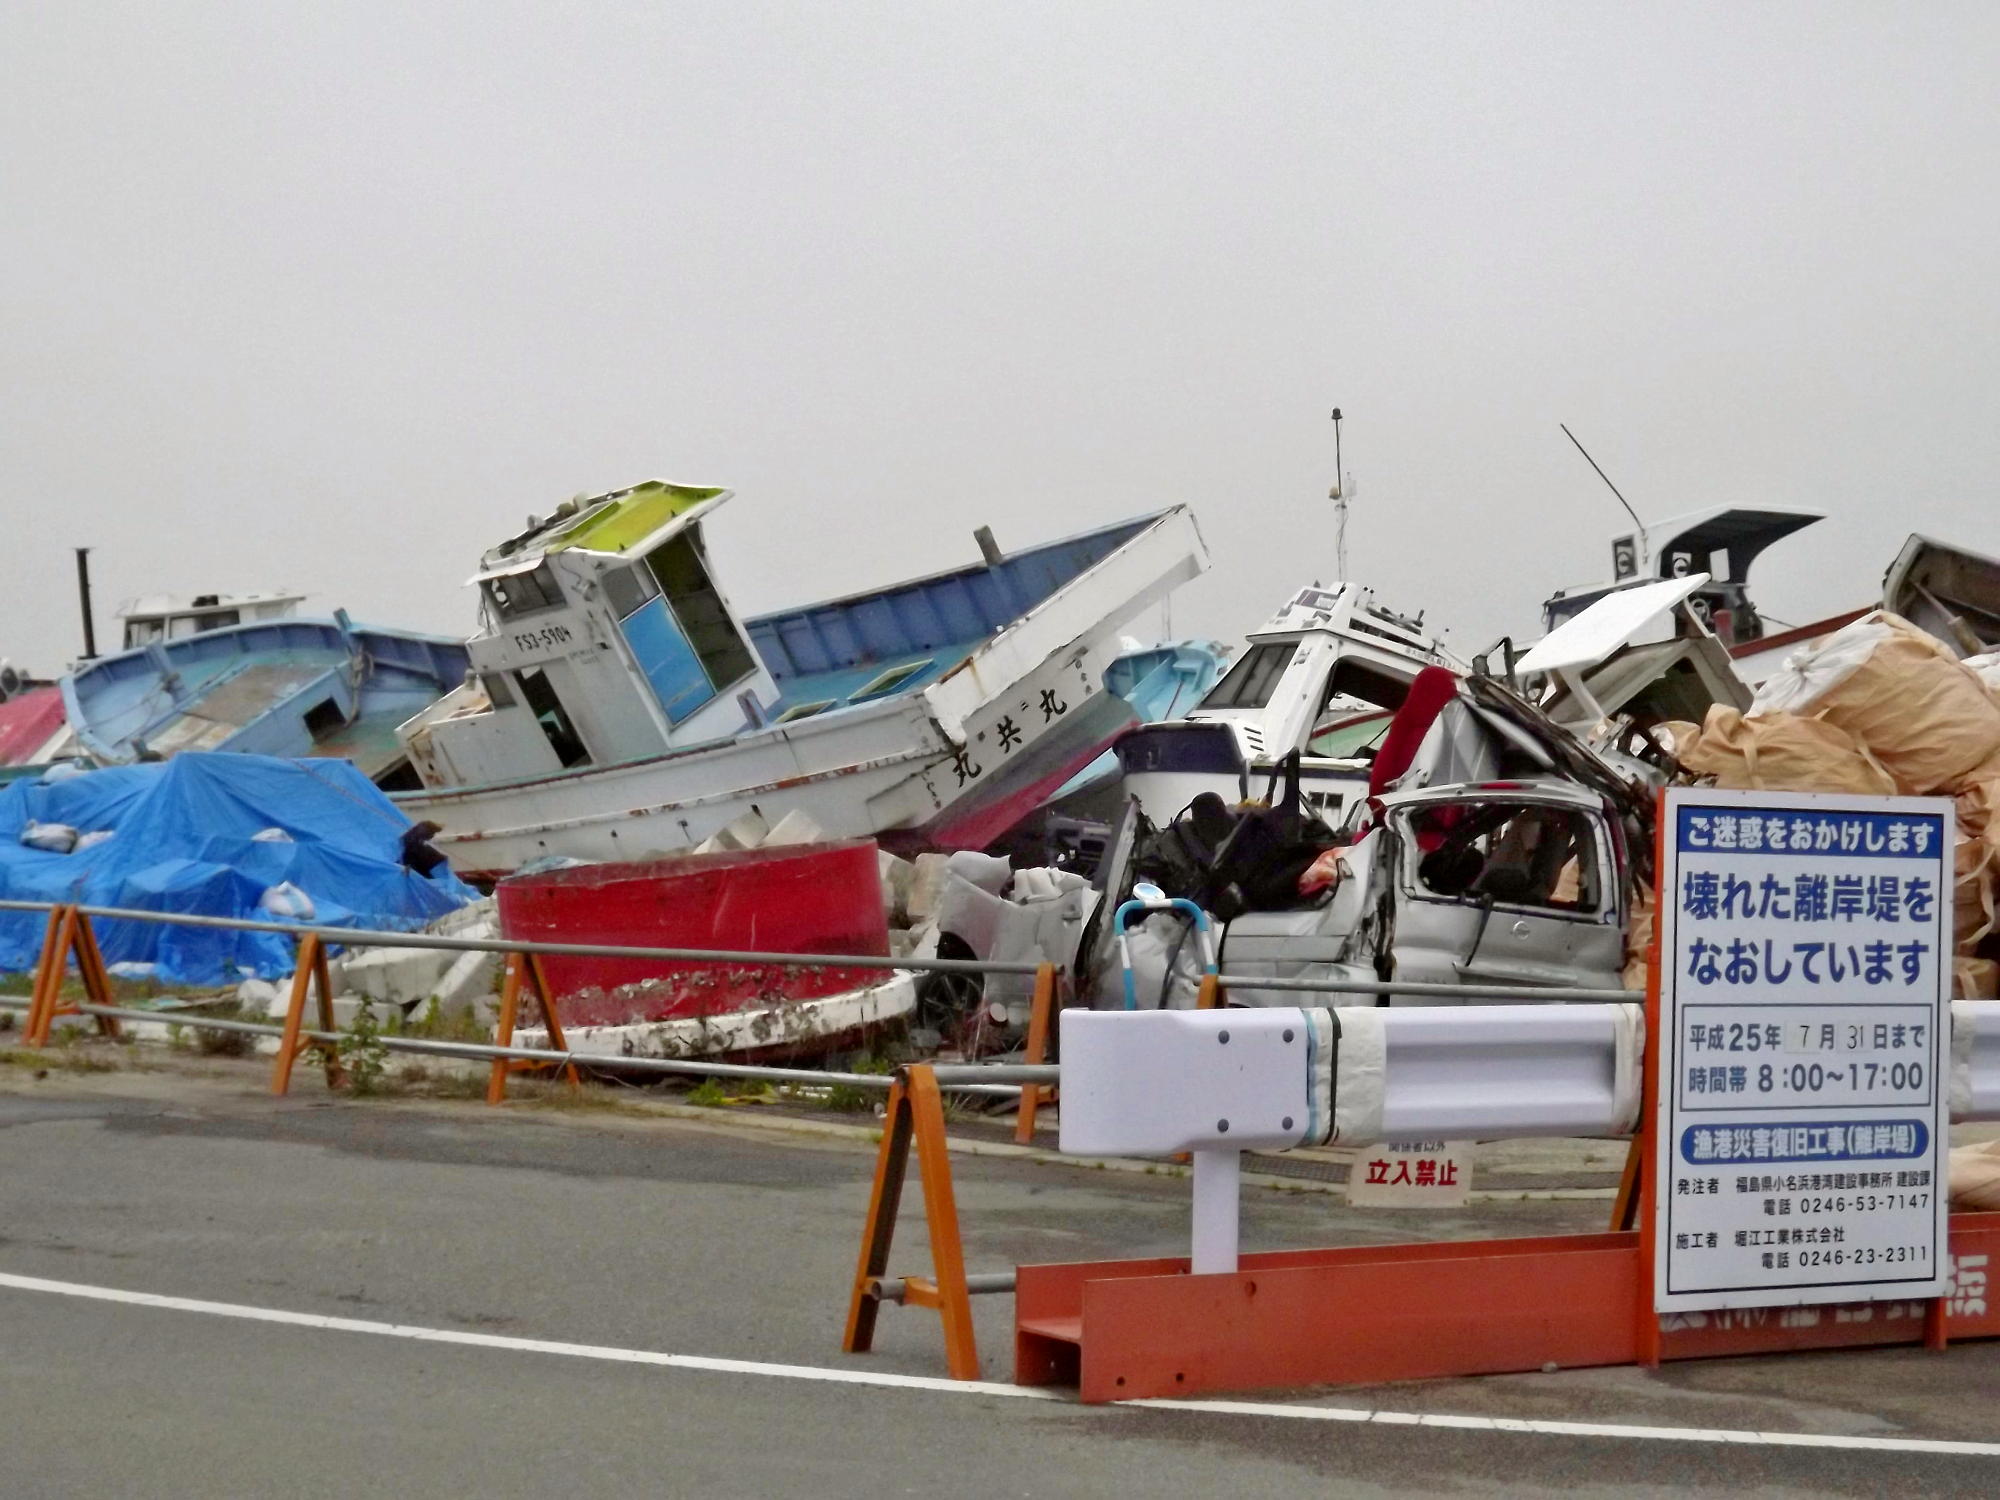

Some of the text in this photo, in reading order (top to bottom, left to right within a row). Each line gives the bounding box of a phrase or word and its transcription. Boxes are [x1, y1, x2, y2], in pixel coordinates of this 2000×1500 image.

[1688, 816, 1935, 853] ご迷惑をおかけします
[1683, 871, 1935, 923] 壊れた離岸堤を
[1687, 937, 1930, 986] なおしています
[1688, 1066, 1748, 1094] 時間帯
[1365, 1159, 1458, 1186] 立入禁止
[1678, 1177, 1719, 1195] 発注者
[1763, 1193, 1929, 1216] 電話 0246-53-7147
[1676, 1226, 1845, 1250] 施工者 堀江工業株式会社
[1761, 1246, 1926, 1269] 電話 0246-23-2311
